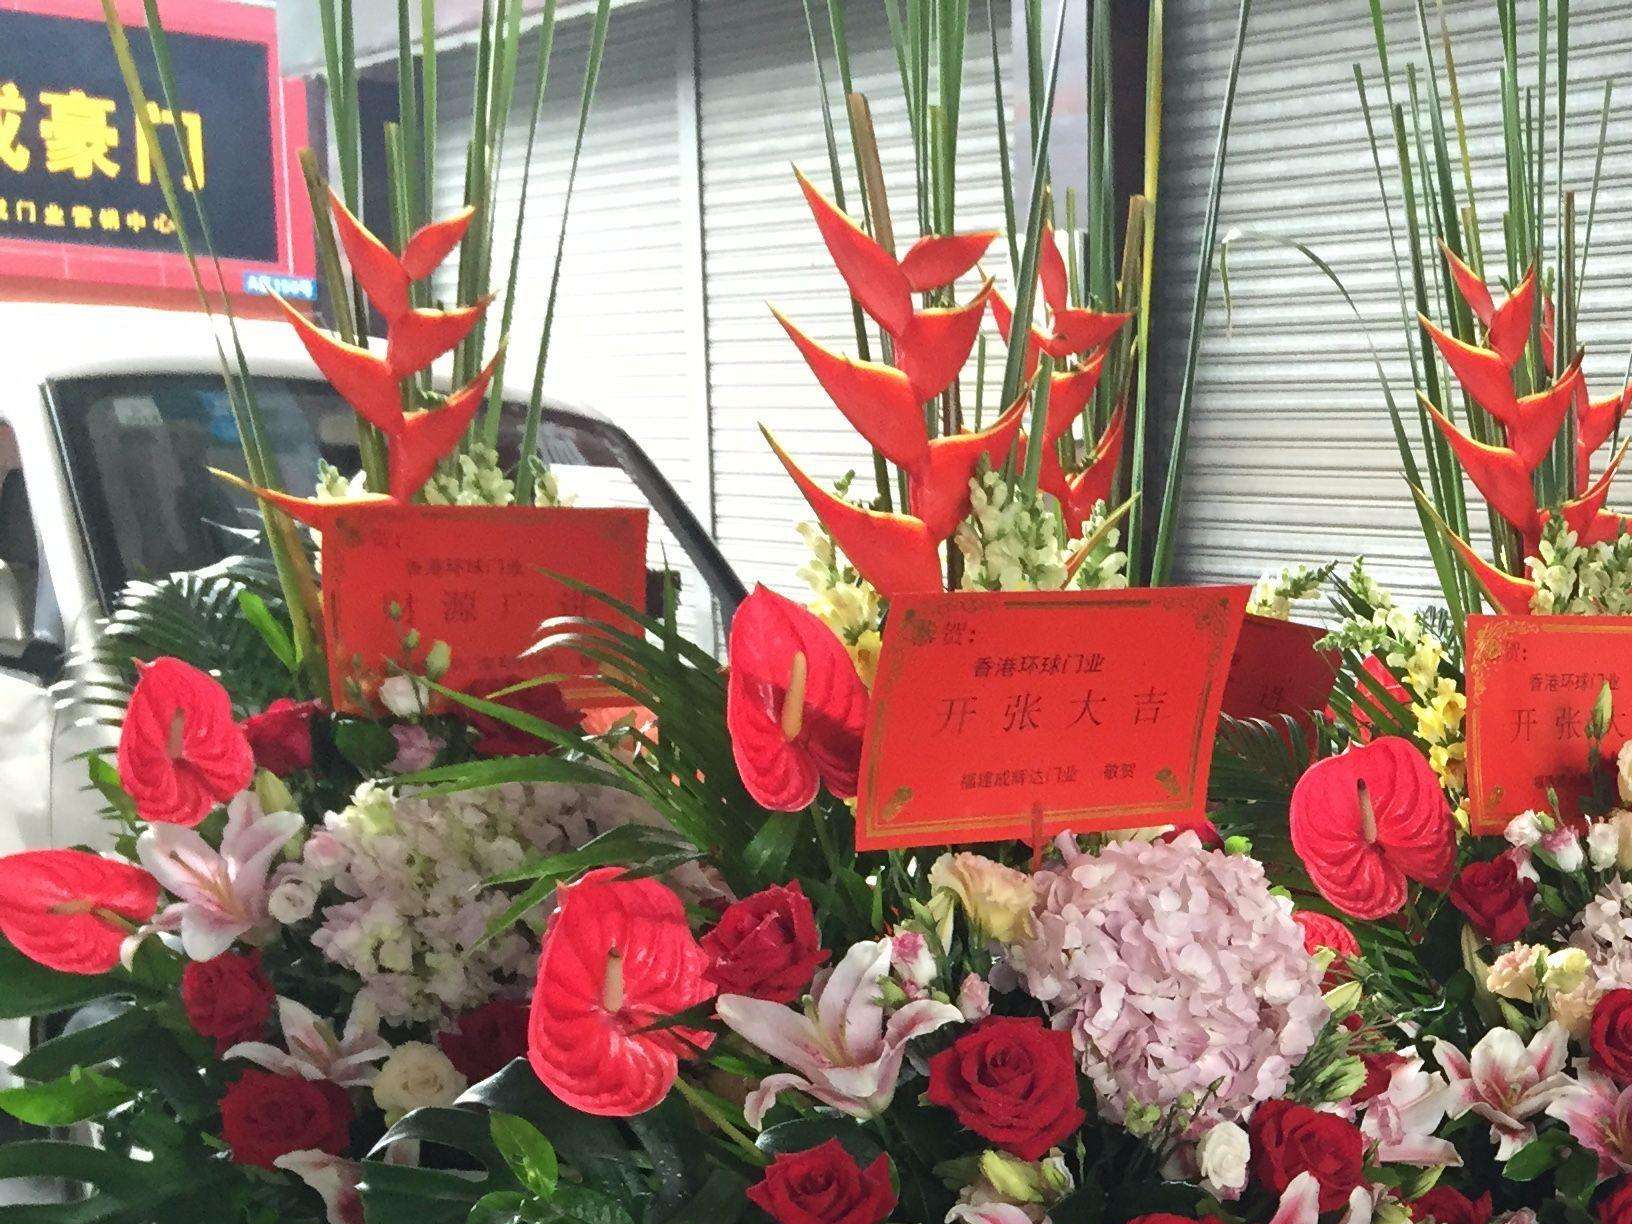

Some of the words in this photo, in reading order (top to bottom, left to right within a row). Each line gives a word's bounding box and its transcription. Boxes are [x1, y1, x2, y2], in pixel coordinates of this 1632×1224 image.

[974, 653, 1106, 678] 香港环球门业
[1529, 673, 1621, 692] 香港环球门业
[932, 685, 1171, 737] 开张大吉
